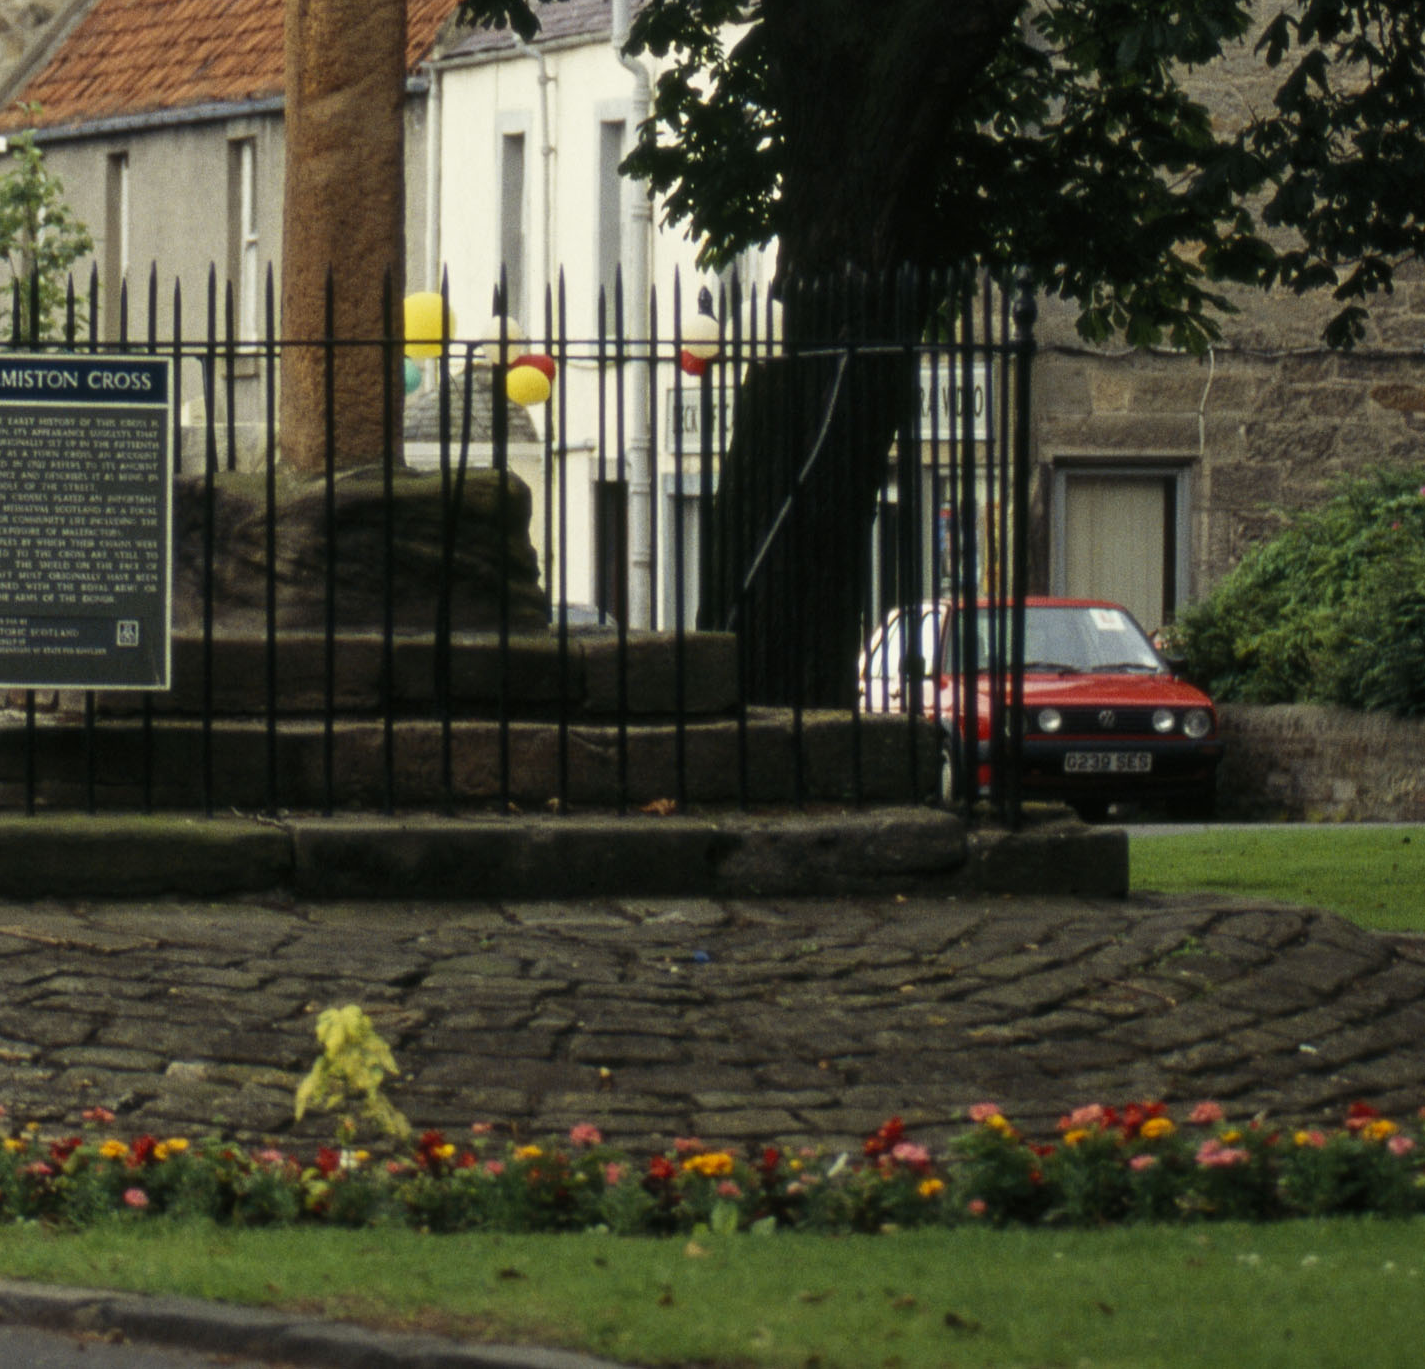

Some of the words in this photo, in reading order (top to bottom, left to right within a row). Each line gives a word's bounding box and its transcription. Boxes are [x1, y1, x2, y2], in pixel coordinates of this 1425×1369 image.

[87, 372, 151, 391] CROSS
[39, 417, 75, 426] HISTORY
[32, 428, 84, 437] APPEARANCE
[93, 440, 109, 449] THE
[33, 450, 59, 459] TOWN
[42, 484, 57, 493] THE
[55, 506, 102, 515] SCOTLAND
[35, 550, 52, 559] THE
[15, 561, 33, 570] THE
[48, 572, 101, 581] ORIGINALLY
[56, 583, 74, 592] THE
[59, 594, 77, 603] THE
[30, 627, 80, 637] SCOTLAND
